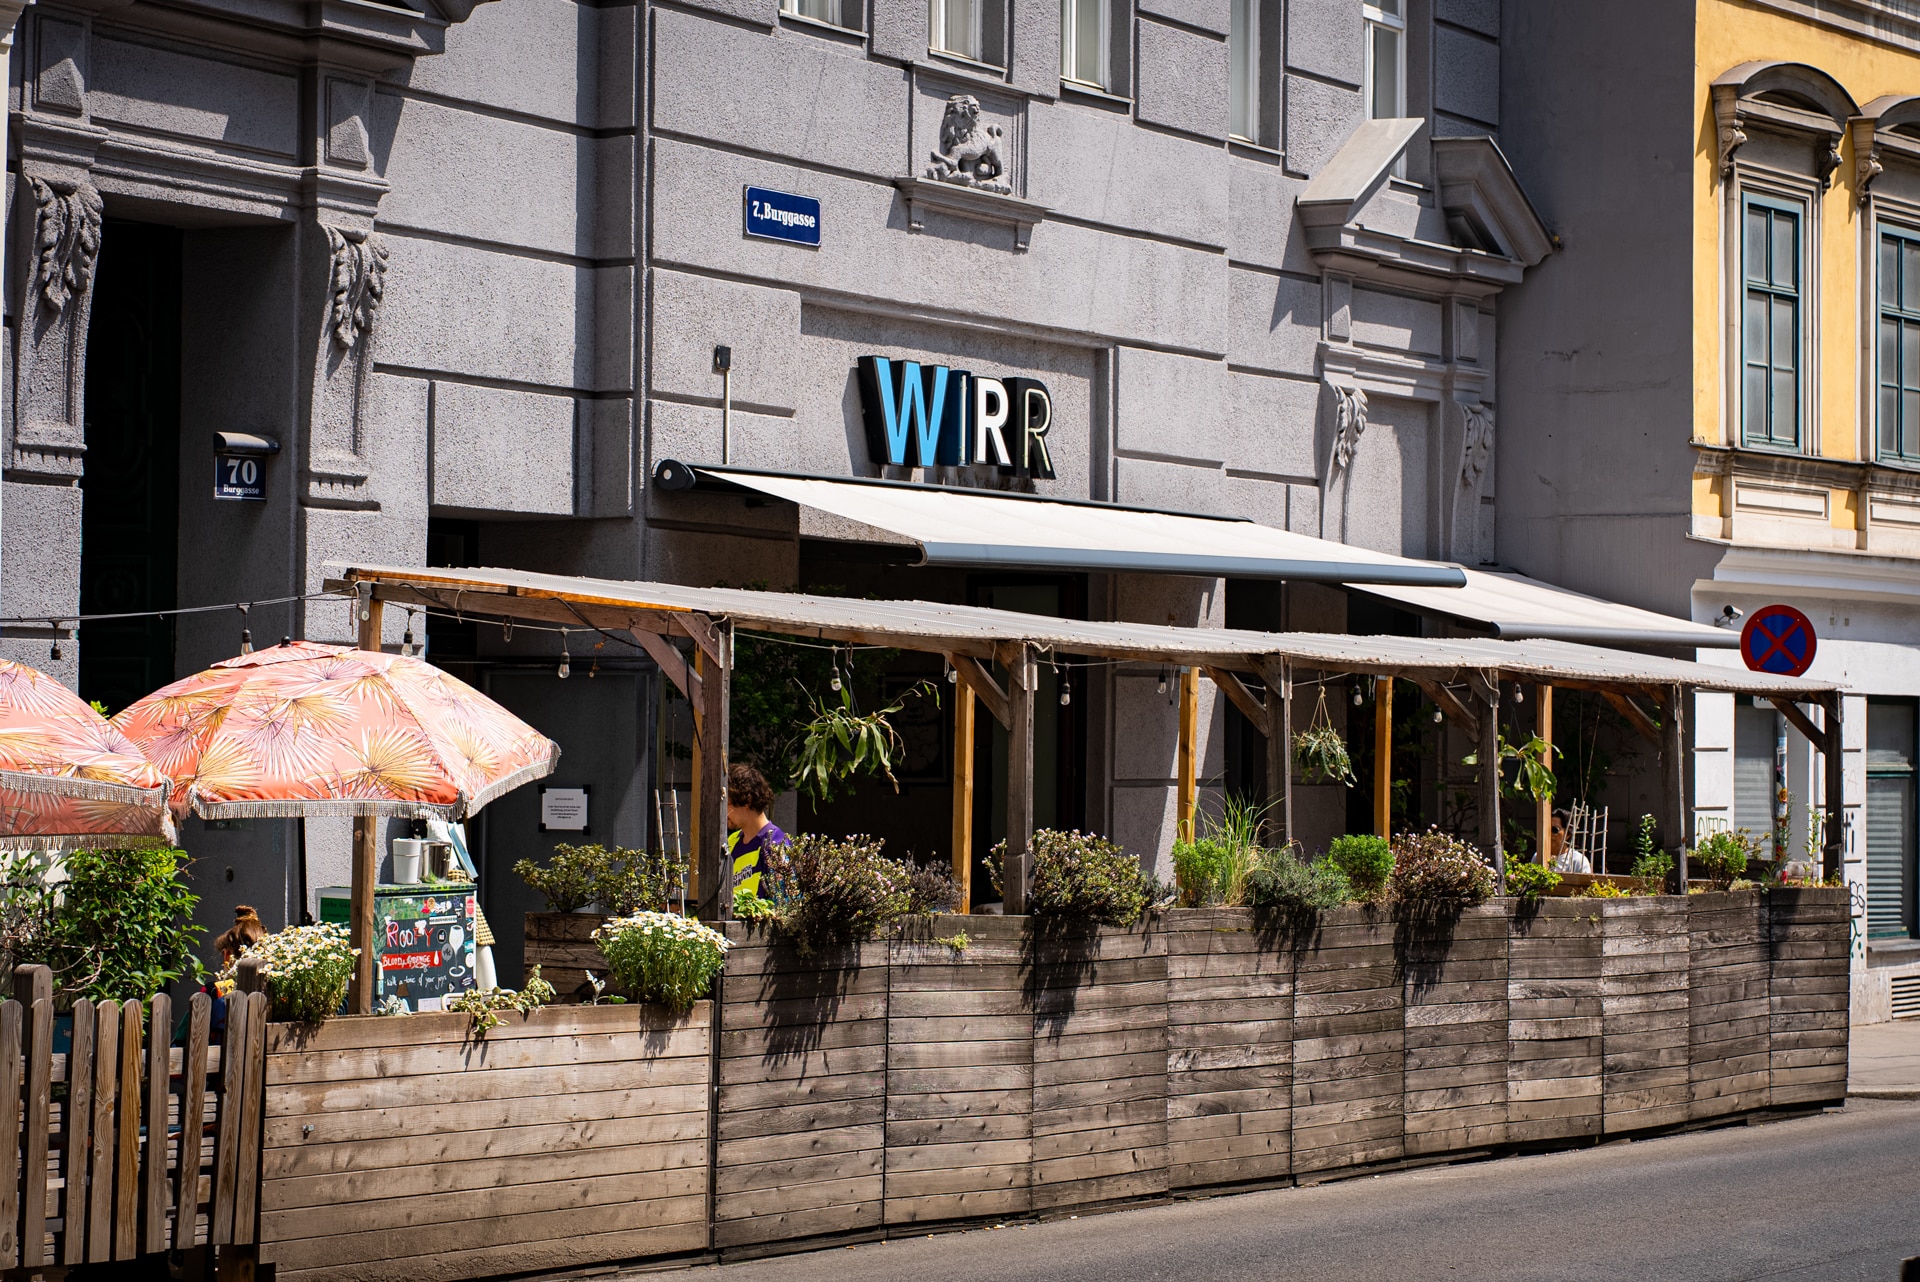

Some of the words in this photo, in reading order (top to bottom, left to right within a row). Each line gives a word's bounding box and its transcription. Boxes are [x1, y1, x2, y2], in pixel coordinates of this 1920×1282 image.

[857, 355, 1057, 480] WIRR
[226, 458, 257, 485] 70
[223, 484, 260, 496] Burggasse
